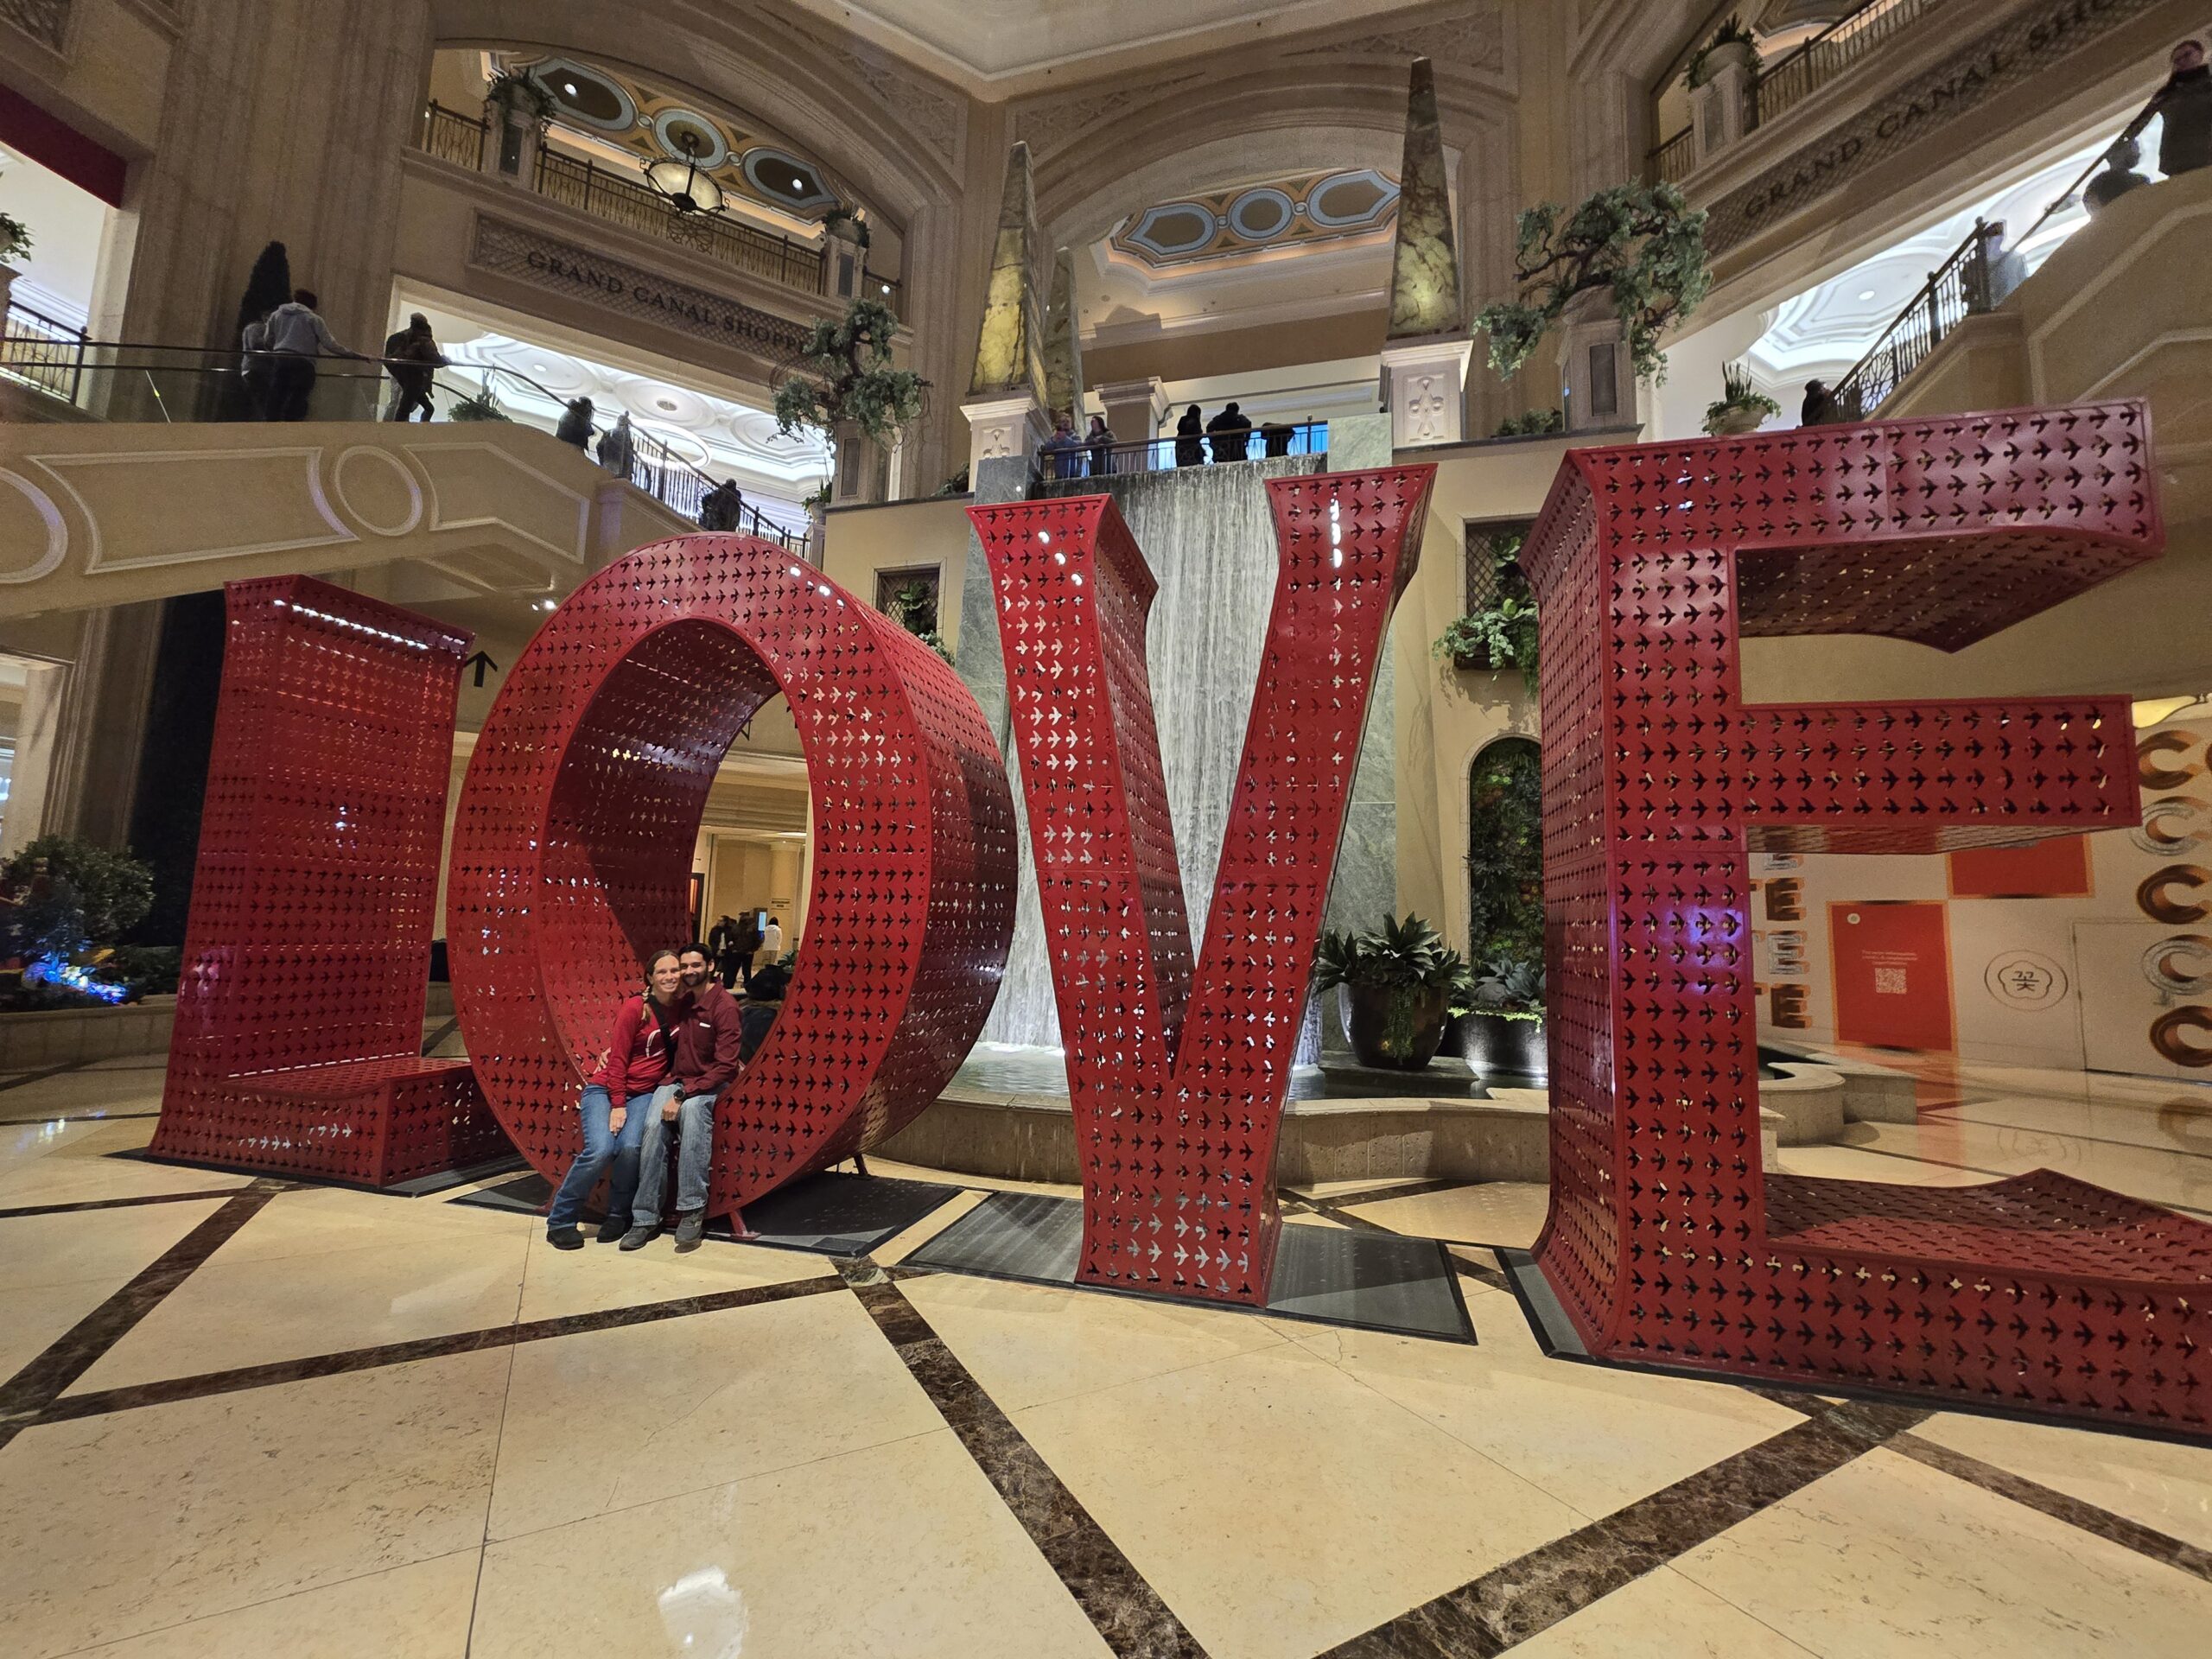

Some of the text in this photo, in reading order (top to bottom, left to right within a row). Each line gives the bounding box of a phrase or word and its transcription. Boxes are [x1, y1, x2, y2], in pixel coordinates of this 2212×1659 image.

[1745, 138, 1861, 218] GRAND
[1877, 54, 2012, 139] CANAL
[527, 251, 804, 353] GRAND CANAL SHOPP
